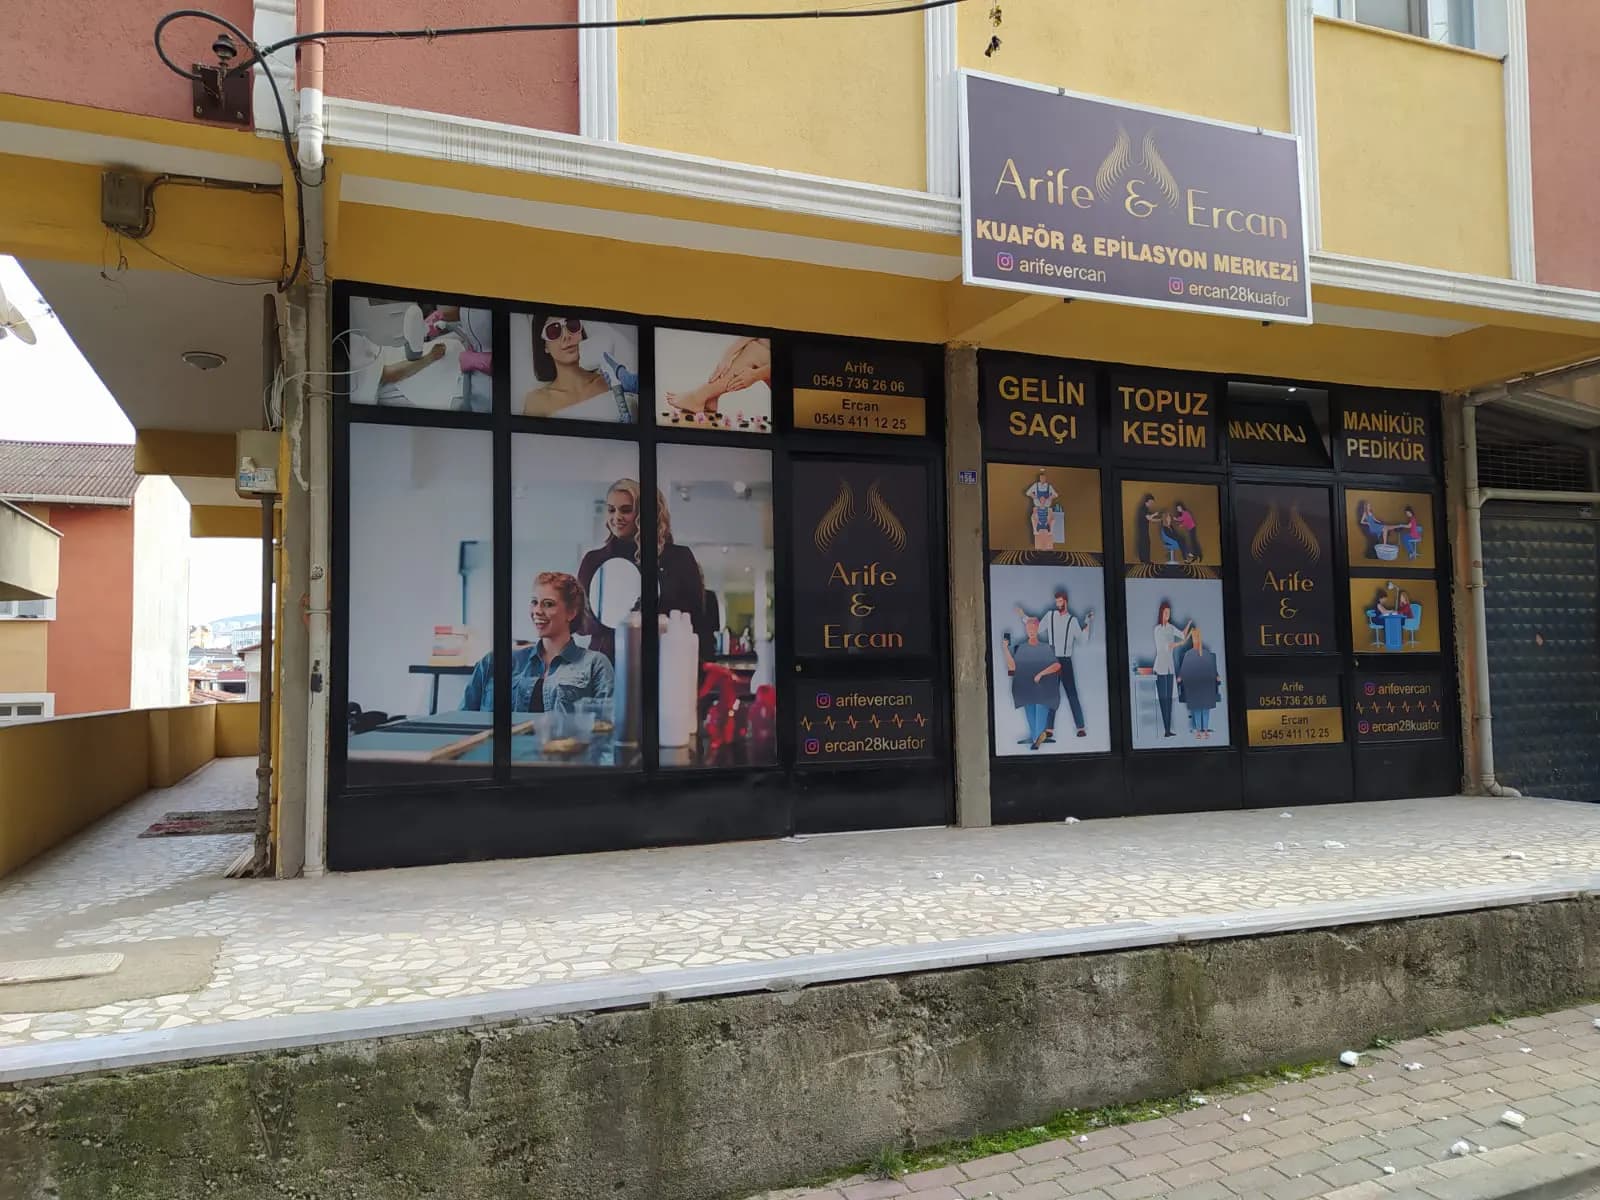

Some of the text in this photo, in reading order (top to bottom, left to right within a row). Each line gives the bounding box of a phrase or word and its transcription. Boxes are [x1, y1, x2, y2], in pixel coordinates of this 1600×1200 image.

[995, 158, 1288, 239] Arife & Ercan
[976, 219, 1299, 283] KUAFÖR & EPİLASYON MERKEZİ
[1019, 256, 1107, 284] arifevercan
[1188, 284, 1292, 307] ercan28kuafor
[845, 361, 874, 375] Arife
[813, 374, 905, 393] 0545 736 26 06
[999, 374, 1085, 406] GELİN
[842, 398, 879, 412] Ercan
[1118, 386, 1209, 416] TOPUZ
[814, 412, 906, 430] 0545 411 12 25
[1009, 411, 1077, 444] SAÇI
[1228, 420, 1307, 444] MAKYAJ
[1343, 409, 1425, 436] MANİKÜR
[1123, 418, 1206, 449] KESİM
[1346, 437, 1425, 462] PEDİKÜR
[828, 561, 897, 586] Arife
[1262, 569, 1314, 592] Arife
[850, 593, 876, 617] &
[1279, 597, 1297, 619] &
[824, 624, 903, 649] Ercan
[1260, 624, 1320, 647] Ercan
[1281, 682, 1304, 692] Arife
[1377, 683, 1431, 695] arifevercan
[835, 693, 913, 708] arifevercan
[1259, 695, 1327, 706] 0545 736 26 06
[1281, 715, 1309, 726] Ercan
[1371, 719, 1440, 733] ercan28kuafor
[825, 736, 926, 753] ercan28kuafor
[1261, 727, 1330, 740] 0545 411 12 25
